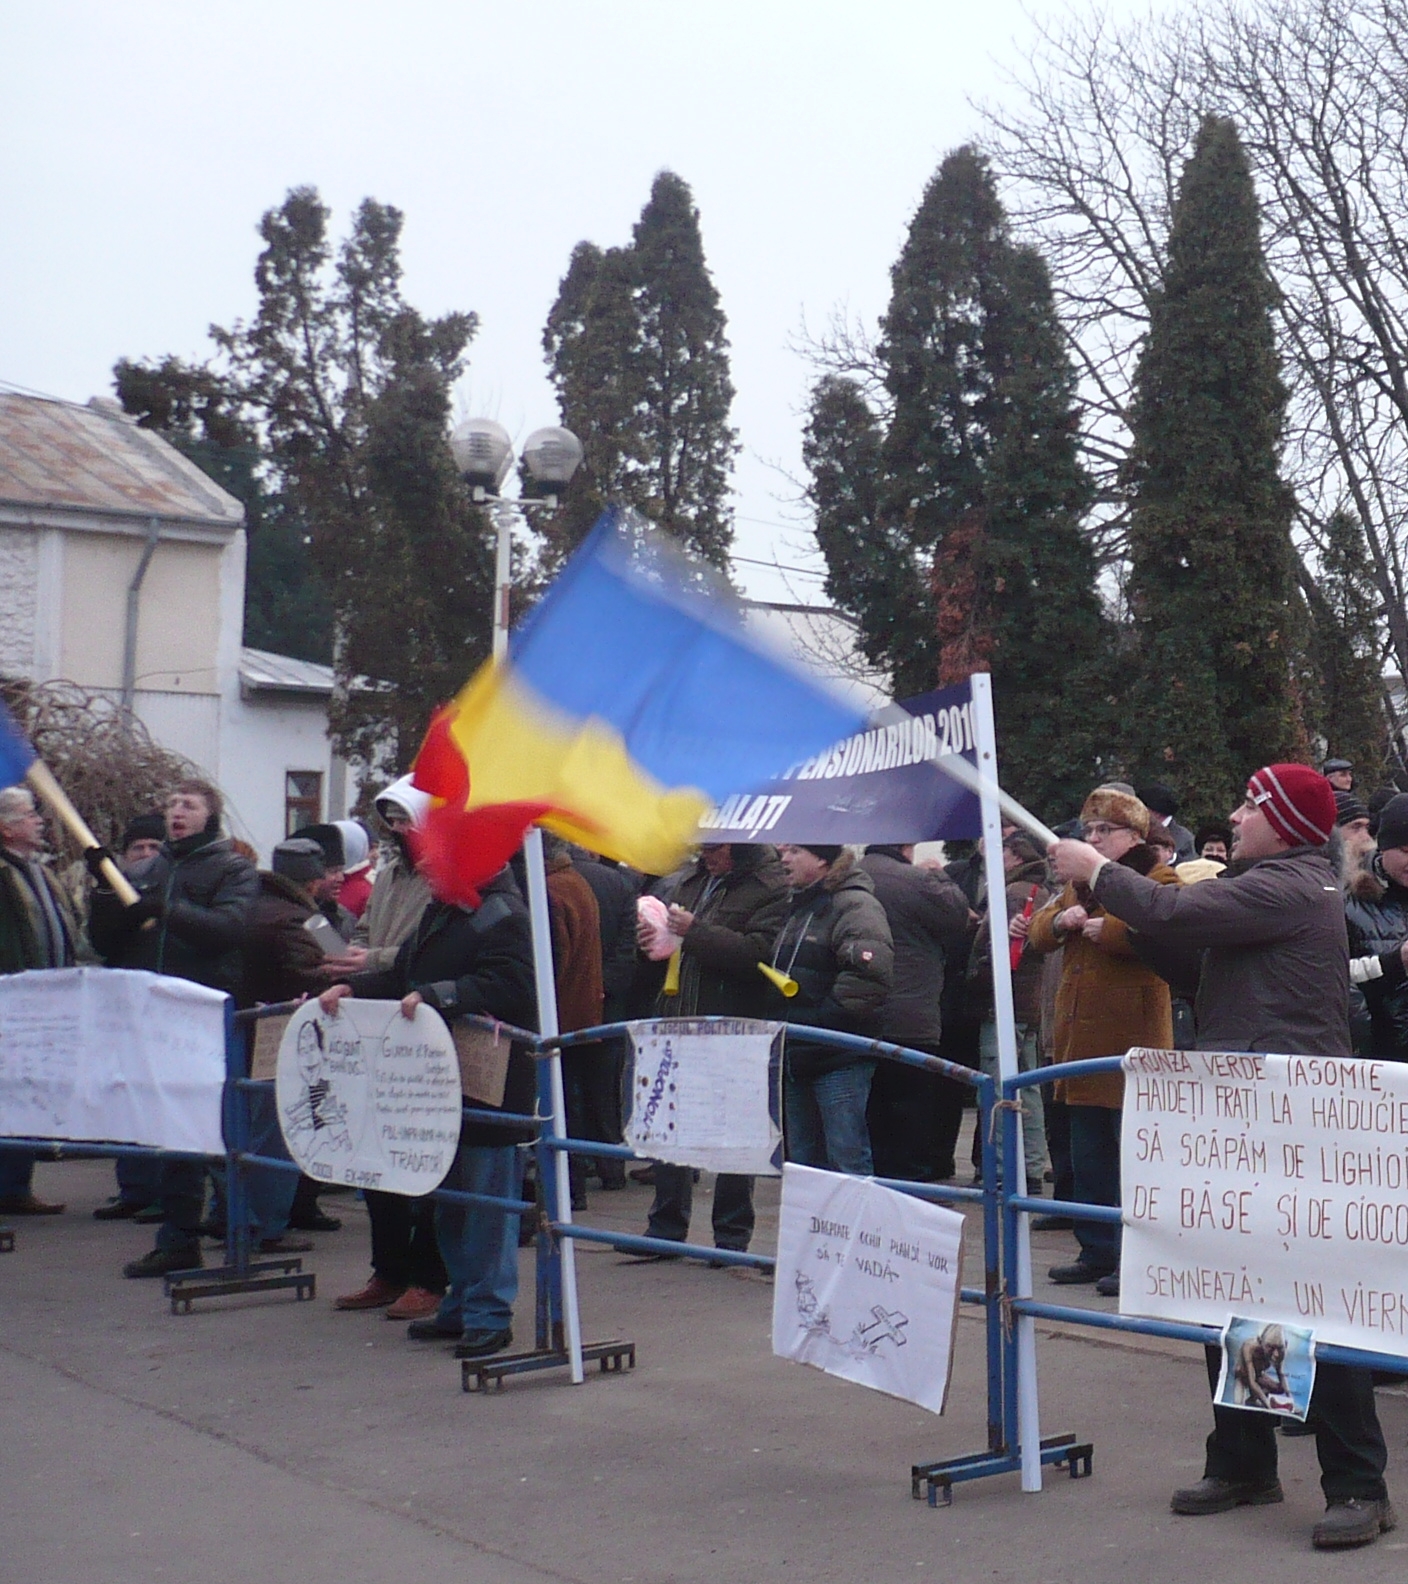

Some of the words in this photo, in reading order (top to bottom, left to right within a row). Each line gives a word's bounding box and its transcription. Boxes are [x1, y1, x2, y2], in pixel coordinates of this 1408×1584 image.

[1201, 1054, 1267, 1081] VERDE
[1215, 1082, 1259, 1129] FRAȚI
[1271, 1090, 1293, 1126] LA
[1136, 1122, 1165, 1163] SĂ
[1180, 1128, 1267, 1174] SCĂPĂM
[1283, 1143, 1305, 1179] DE
[1132, 1184, 1161, 1221] DE
[1308, 1198, 1333, 1240] DE
[928, 1250, 949, 1275] VOR
[1294, 1280, 1325, 1317] UN
